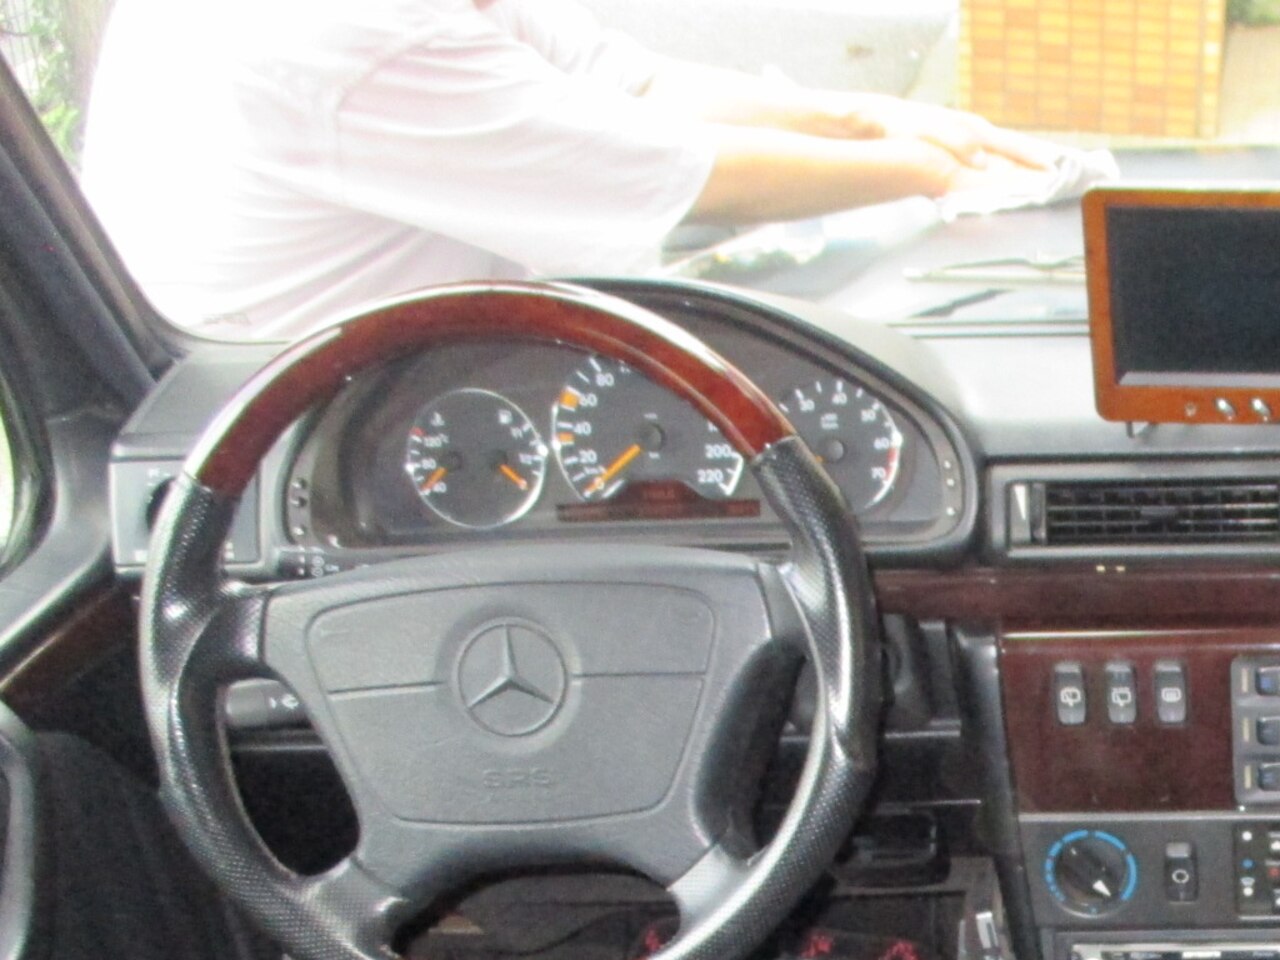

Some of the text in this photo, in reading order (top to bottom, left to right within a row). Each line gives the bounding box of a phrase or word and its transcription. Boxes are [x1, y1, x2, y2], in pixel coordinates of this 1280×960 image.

[596, 372, 614, 387] 80
[578, 393, 597, 407] 60
[832, 391, 847, 405] 40
[573, 421, 592, 435] 40
[873, 436, 889, 450] 60
[579, 449, 597, 463] 20
[705, 443, 732, 458] 200
[697, 469, 724, 484] 220
[871, 466, 886, 479] 70
